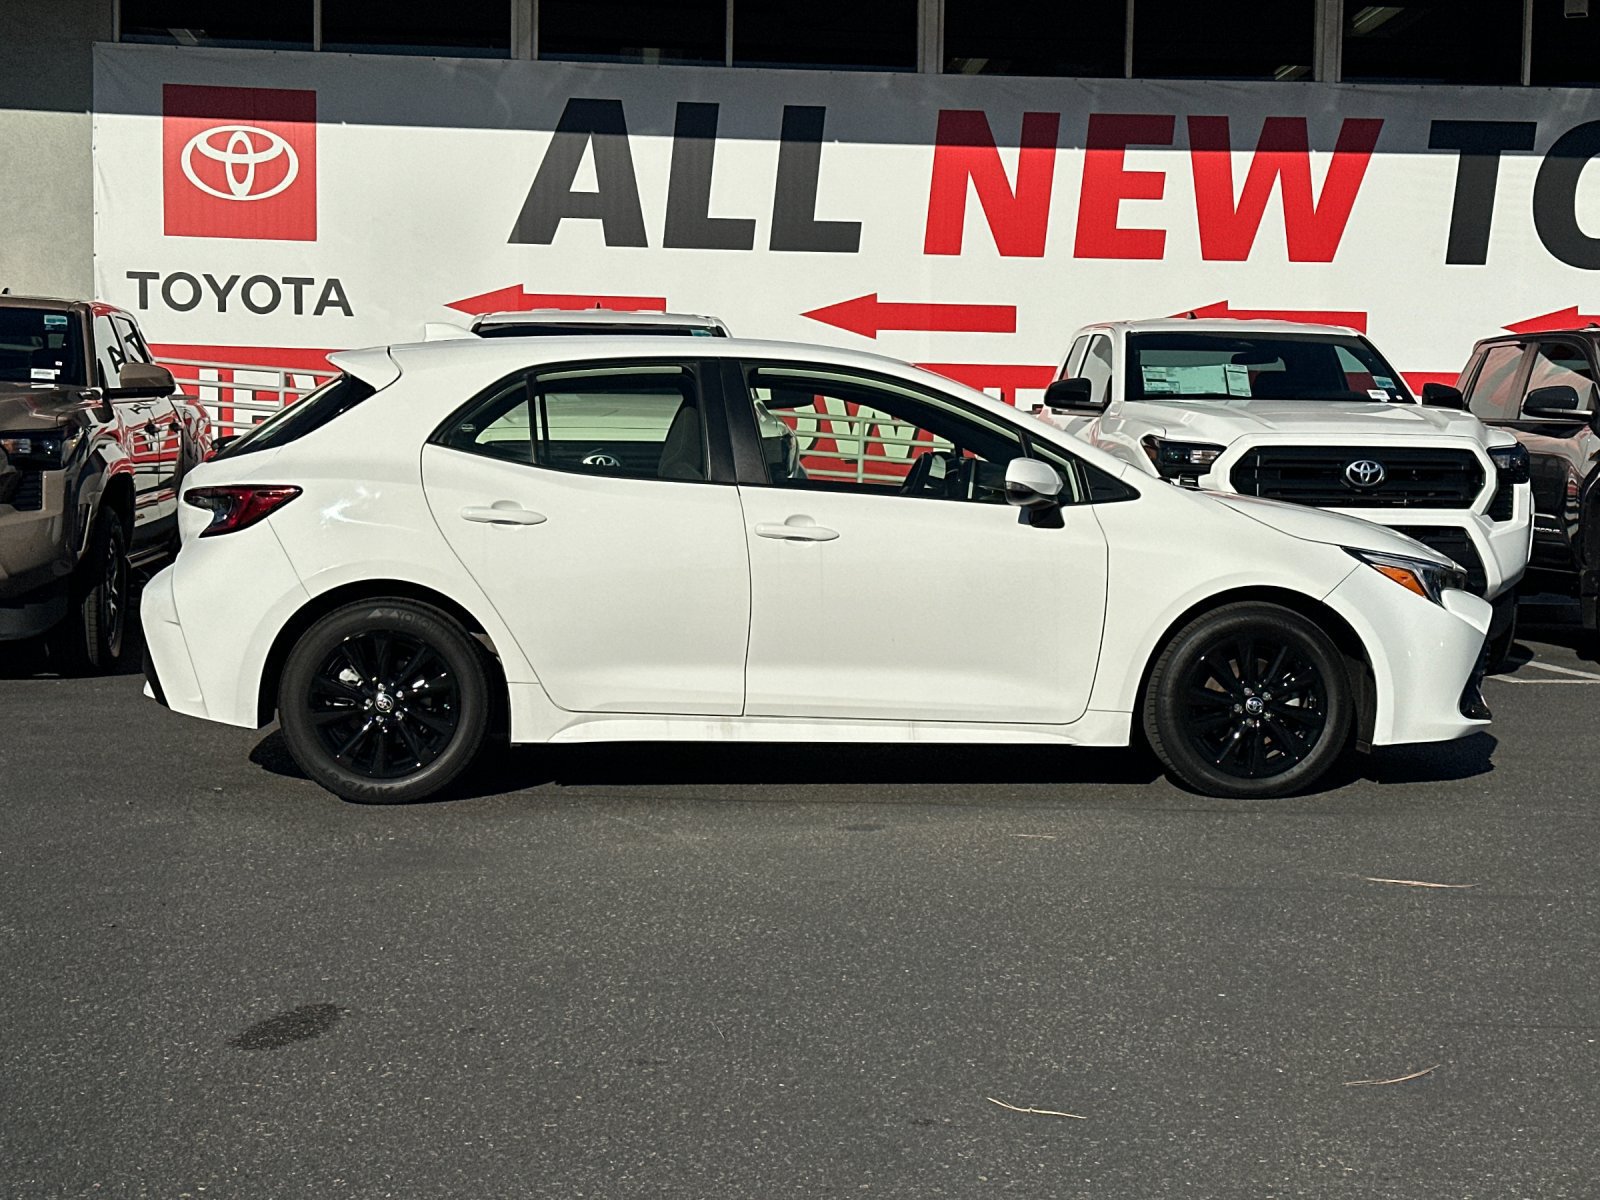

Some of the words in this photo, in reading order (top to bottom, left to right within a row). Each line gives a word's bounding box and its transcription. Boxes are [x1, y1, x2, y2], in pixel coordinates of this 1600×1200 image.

[508, 98, 862, 254] ALL
[924, 111, 1384, 263] NEW
[126, 270, 354, 317] TOYOTA
